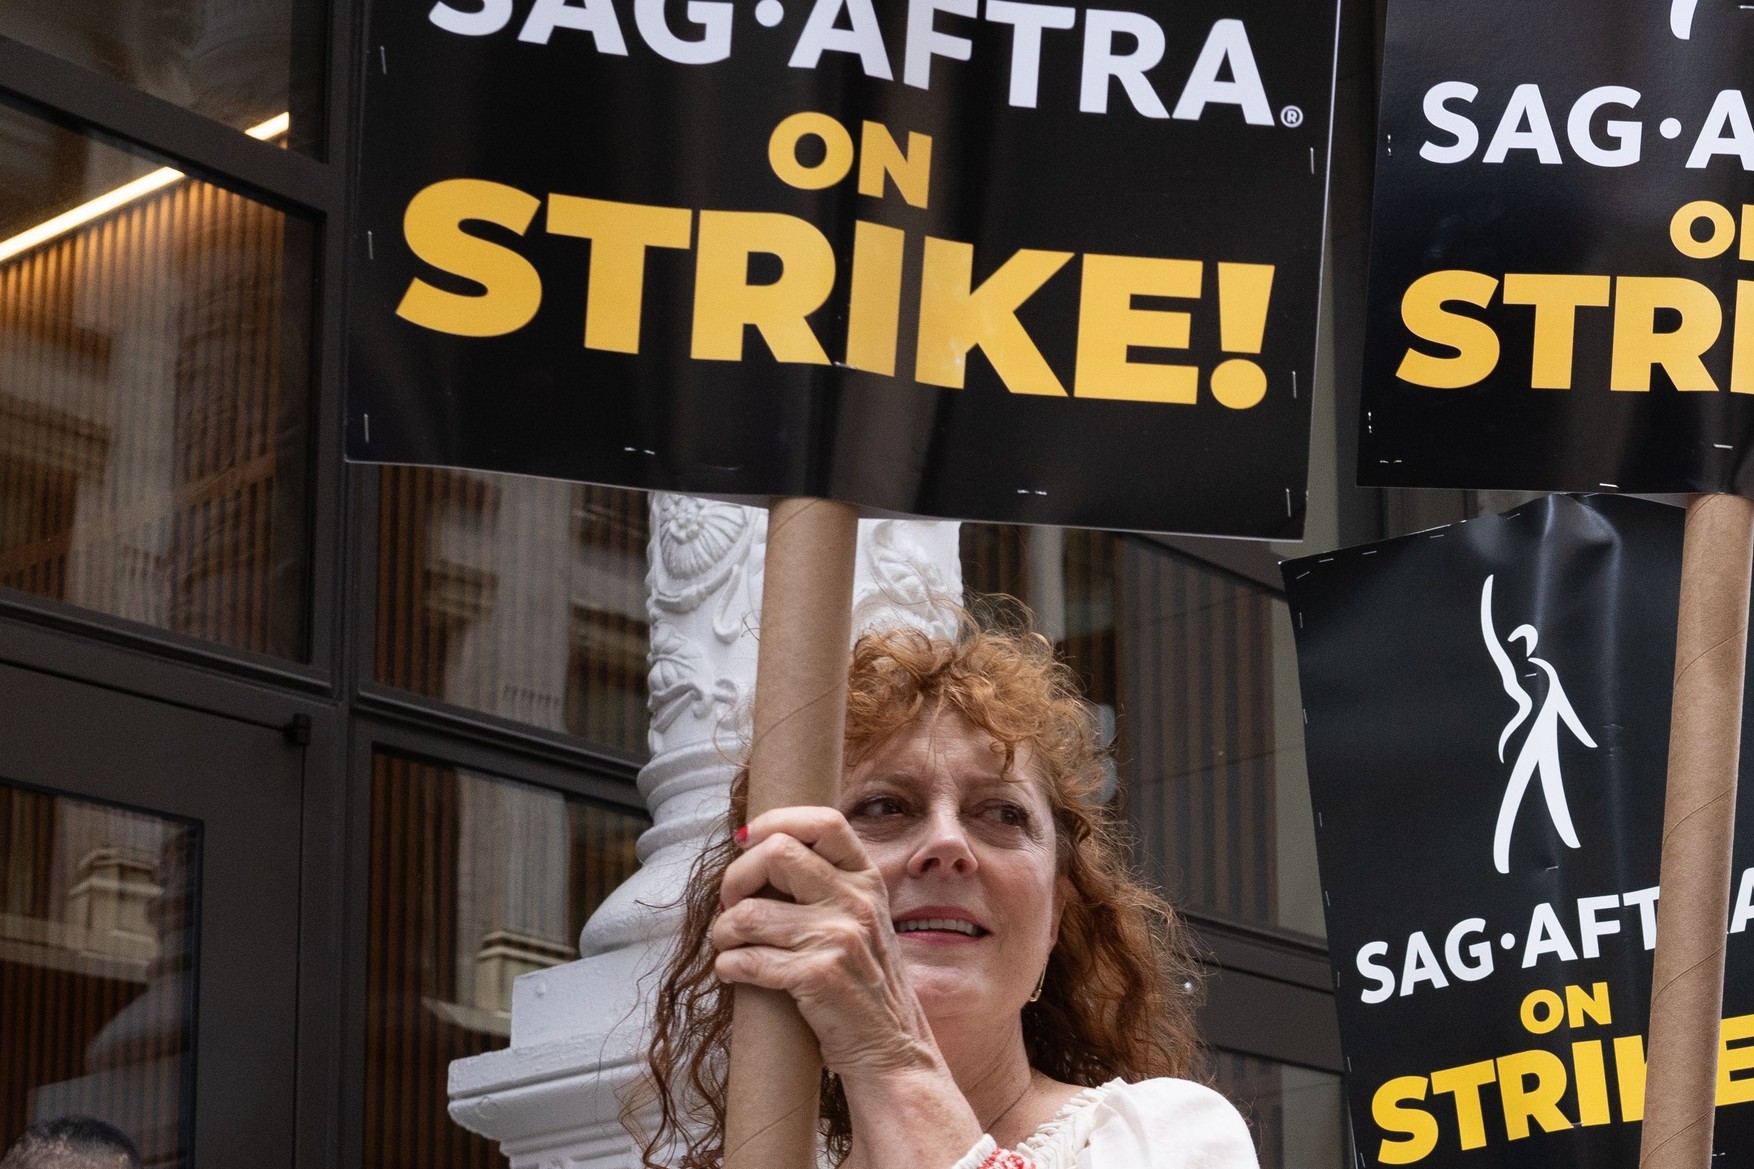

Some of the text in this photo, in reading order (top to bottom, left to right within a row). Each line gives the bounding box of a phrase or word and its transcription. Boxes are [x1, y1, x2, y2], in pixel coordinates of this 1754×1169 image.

[768, 111, 933, 210] ON
[395, 177, 1276, 411] STRIKE!
[1520, 981, 1612, 1035] ON
